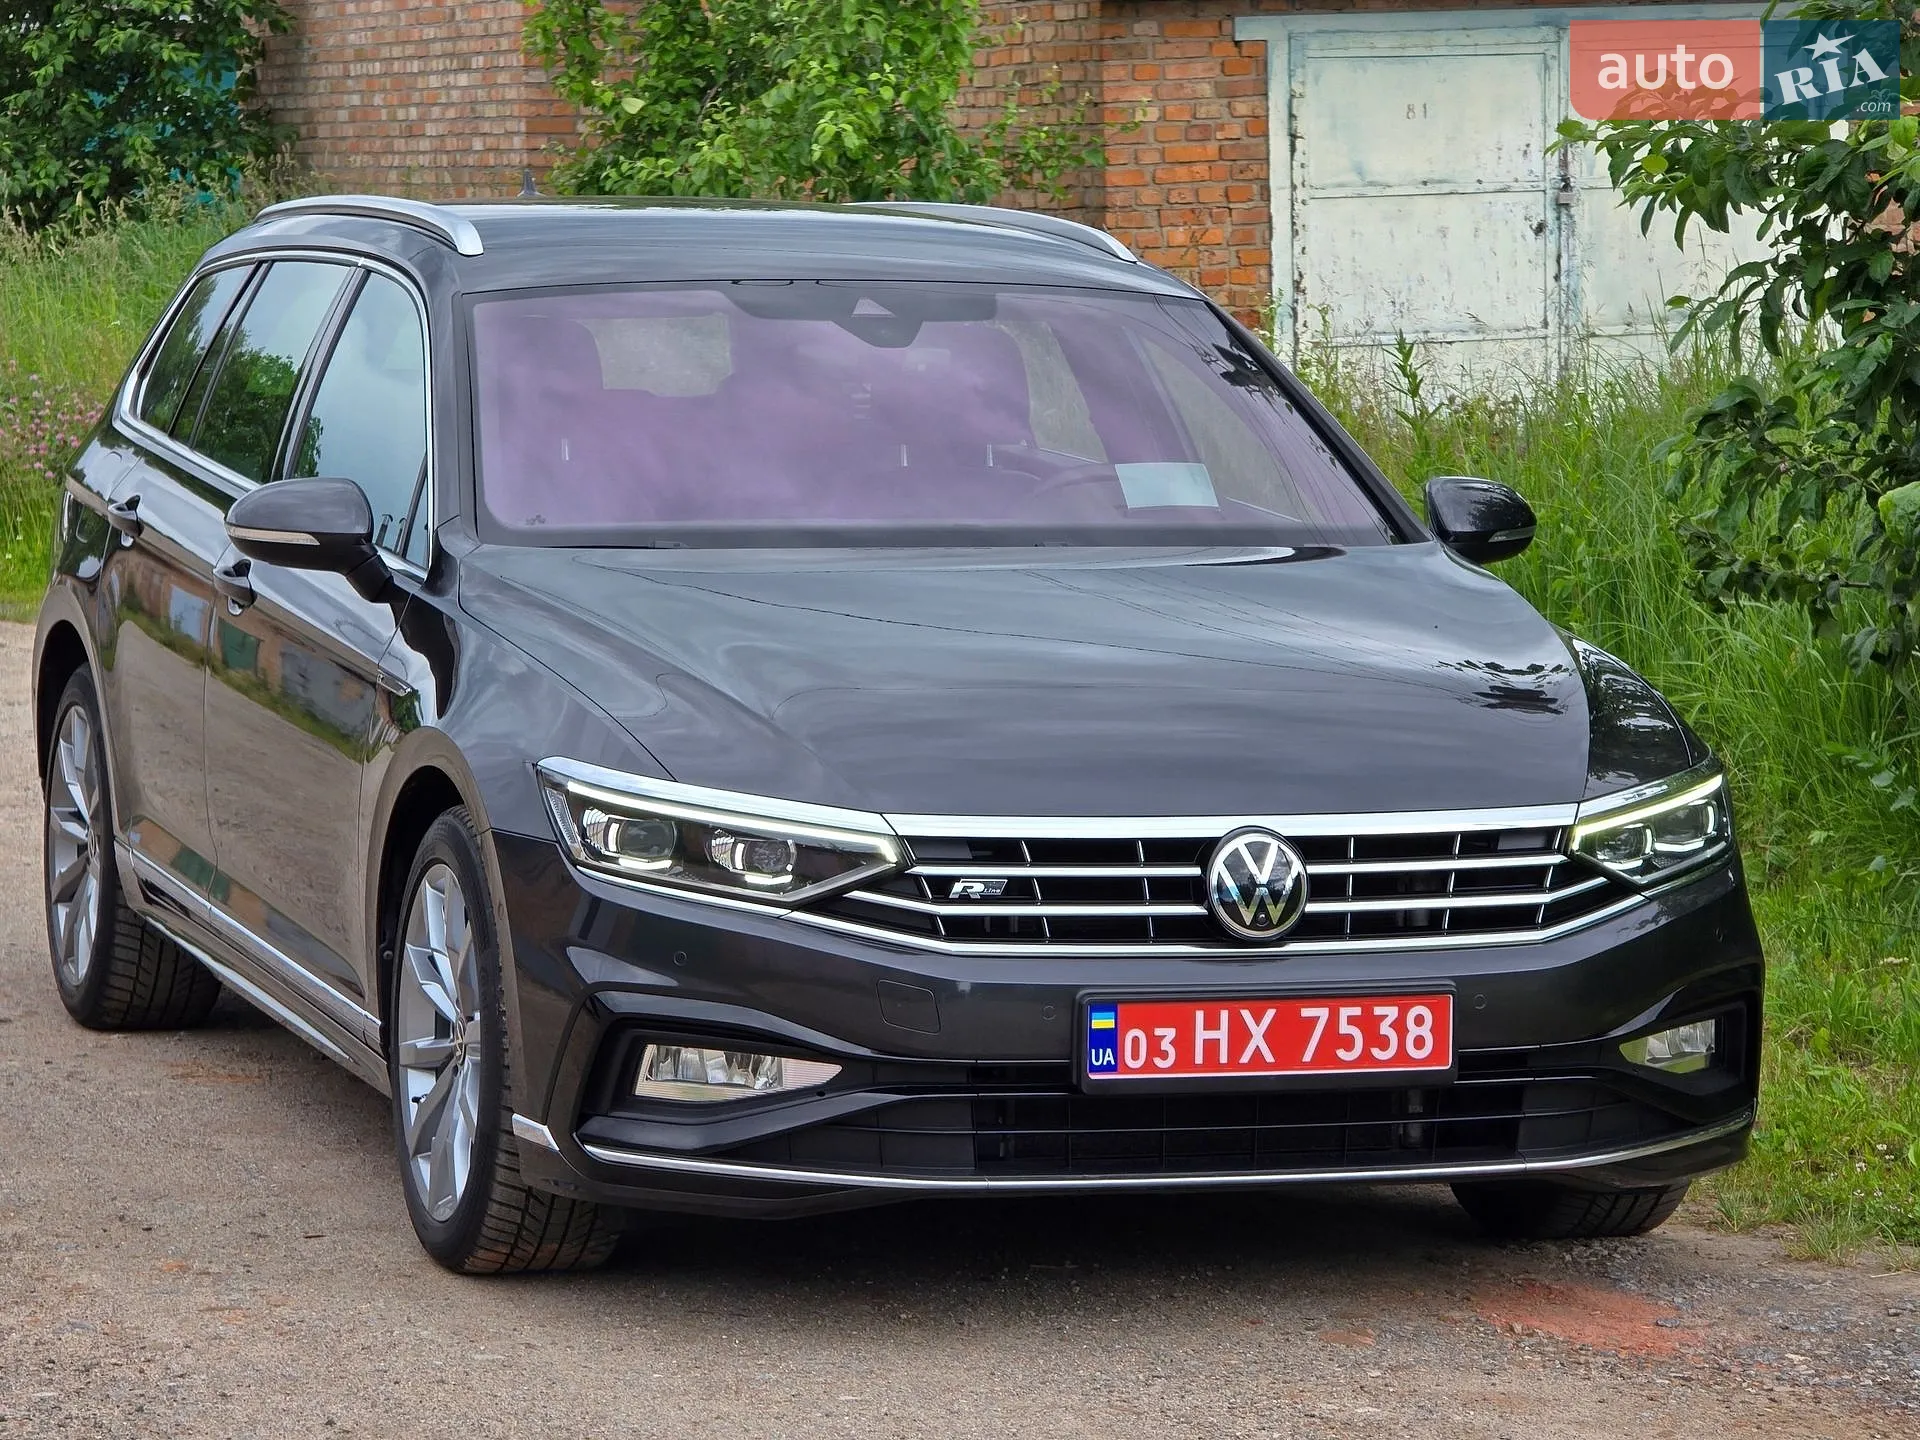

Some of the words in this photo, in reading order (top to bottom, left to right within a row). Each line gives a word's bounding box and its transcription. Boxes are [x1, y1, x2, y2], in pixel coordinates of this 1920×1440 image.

[1406, 102, 1428, 120] 81
[1123, 1028, 1177, 1070] 03
[1194, 1008, 1277, 1065] HX
[1300, 1005, 1434, 1062] 7538
[1091, 1048, 1115, 1066] UA
